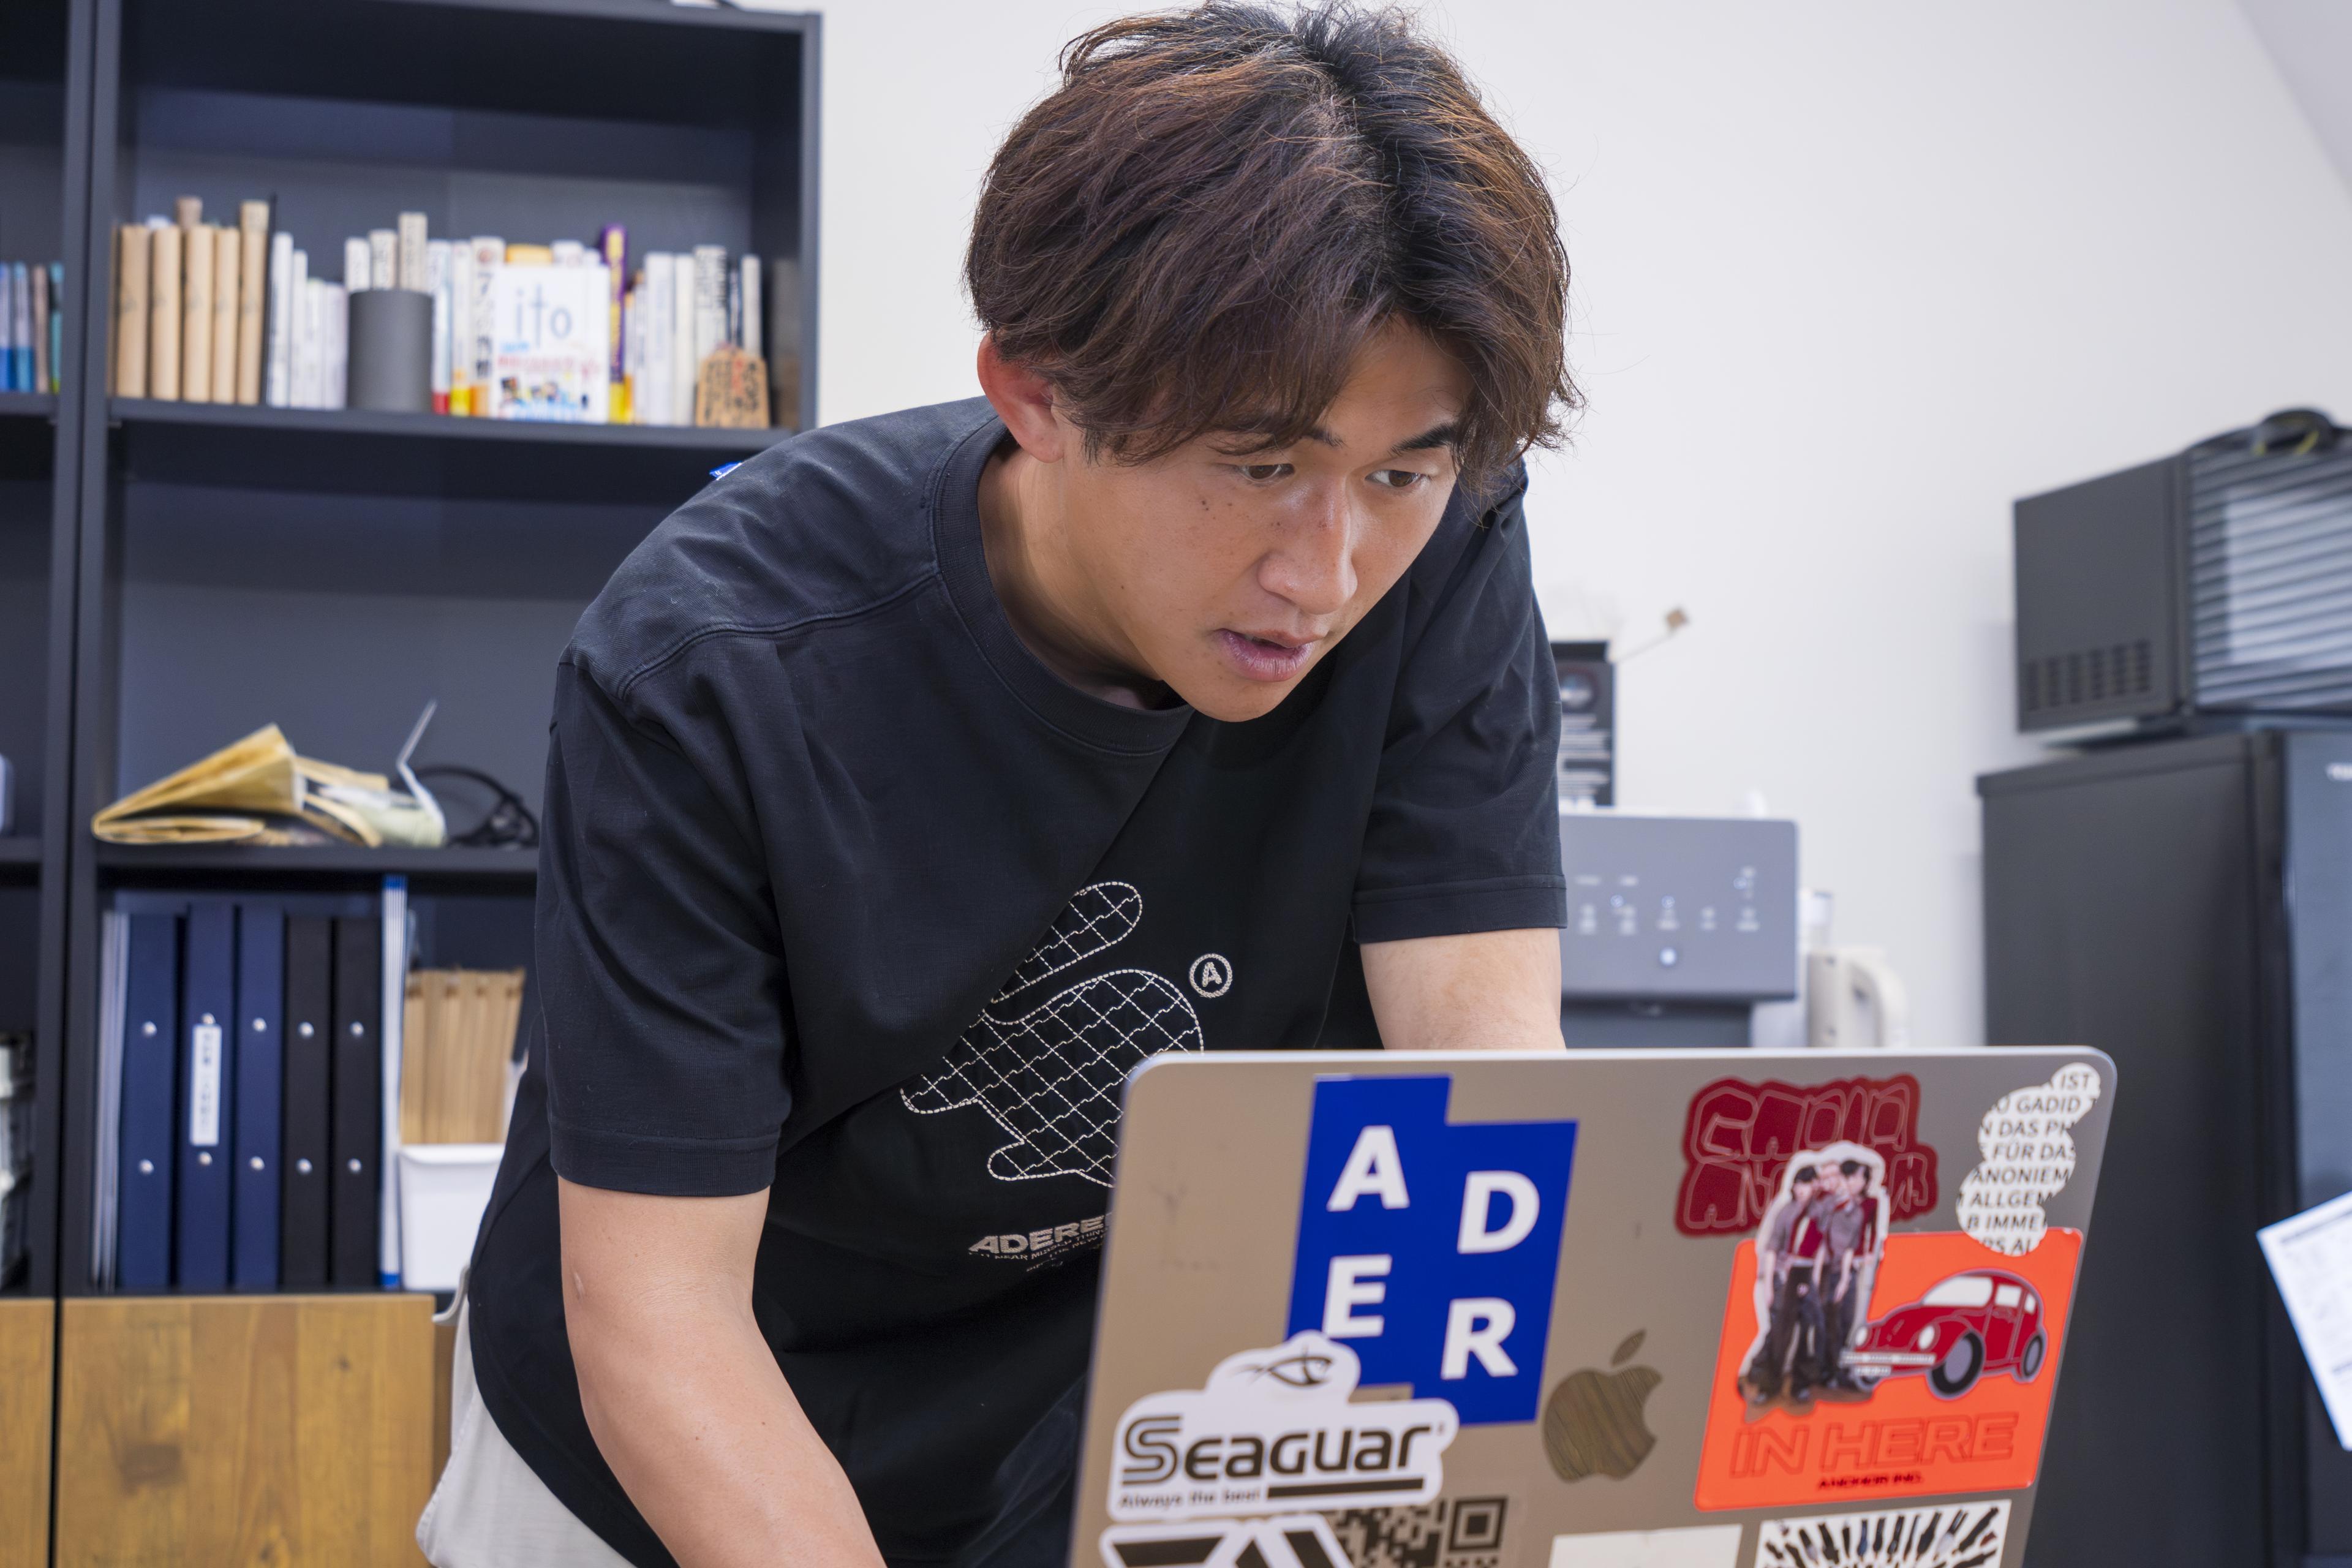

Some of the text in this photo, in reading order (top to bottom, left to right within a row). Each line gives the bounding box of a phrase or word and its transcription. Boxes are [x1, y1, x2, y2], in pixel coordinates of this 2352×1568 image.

[1999, 1119, 2040, 1137] DAS
[1729, 1411, 2020, 1479] IN HERE
